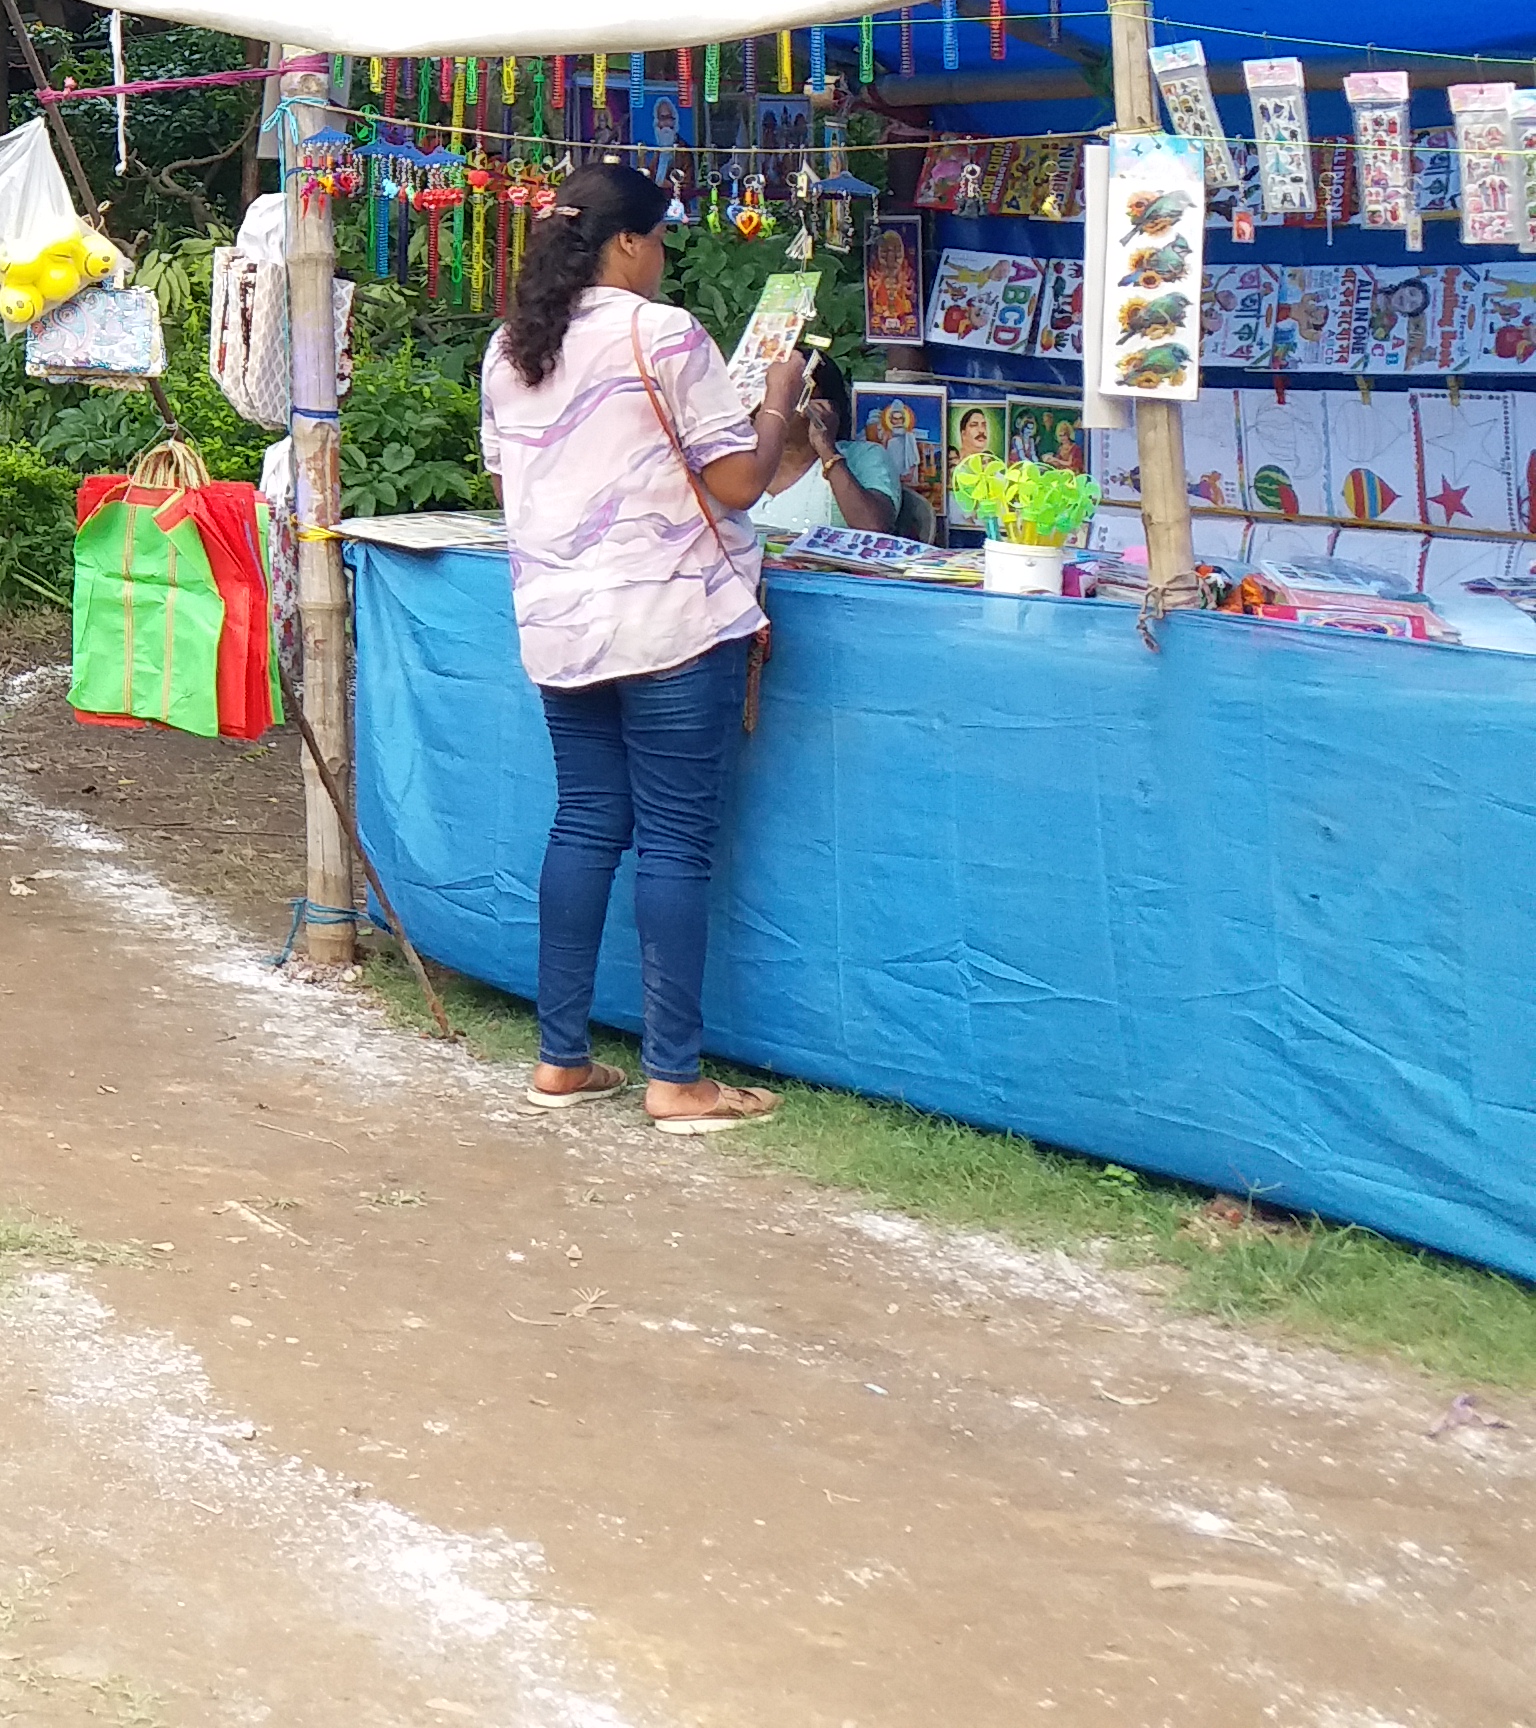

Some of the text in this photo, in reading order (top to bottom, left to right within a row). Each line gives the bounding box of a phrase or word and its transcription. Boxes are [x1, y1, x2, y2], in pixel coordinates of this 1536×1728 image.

[980, 141, 1005, 204] ORD BOO
[1052, 146, 1076, 212] NUMBE
[993, 259, 1038, 346] ABCD
[1351, 279, 1372, 354] ALL IN ONE
